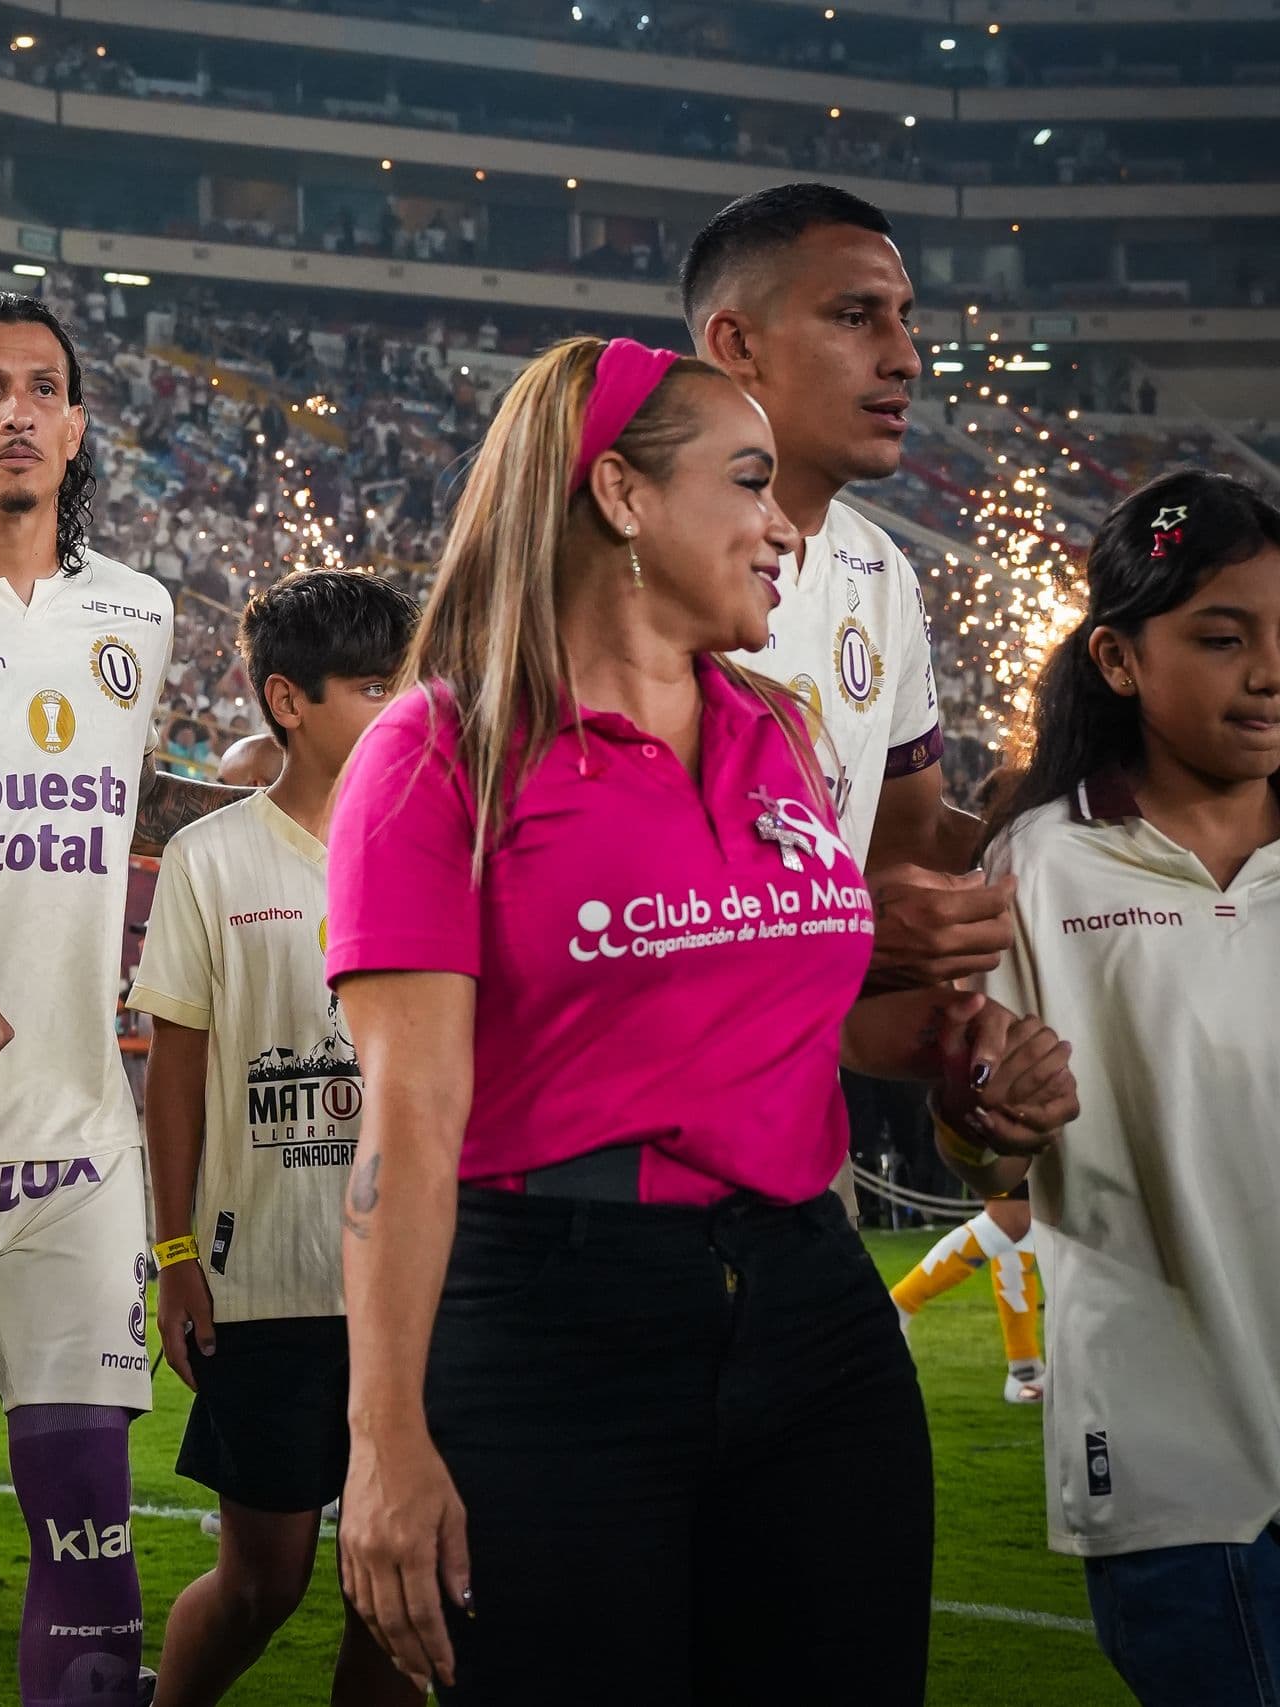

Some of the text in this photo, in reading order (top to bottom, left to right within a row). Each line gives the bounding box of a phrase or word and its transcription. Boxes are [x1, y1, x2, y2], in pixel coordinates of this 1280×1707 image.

[81, 600, 162, 626] JETOUR
[106, 652, 132, 690] U
[848, 641, 867, 693] U
[229, 908, 303, 927] marathon
[623, 888, 712, 933] Club
[721, 885, 762, 920] de
[766, 882, 801, 914] la
[1061, 907, 1183, 934] marathon
[631, 925, 735, 958] Organización
[737, 922, 756, 942] de
[758, 918, 797, 938] lucha
[248, 1077, 365, 1125] MATU
